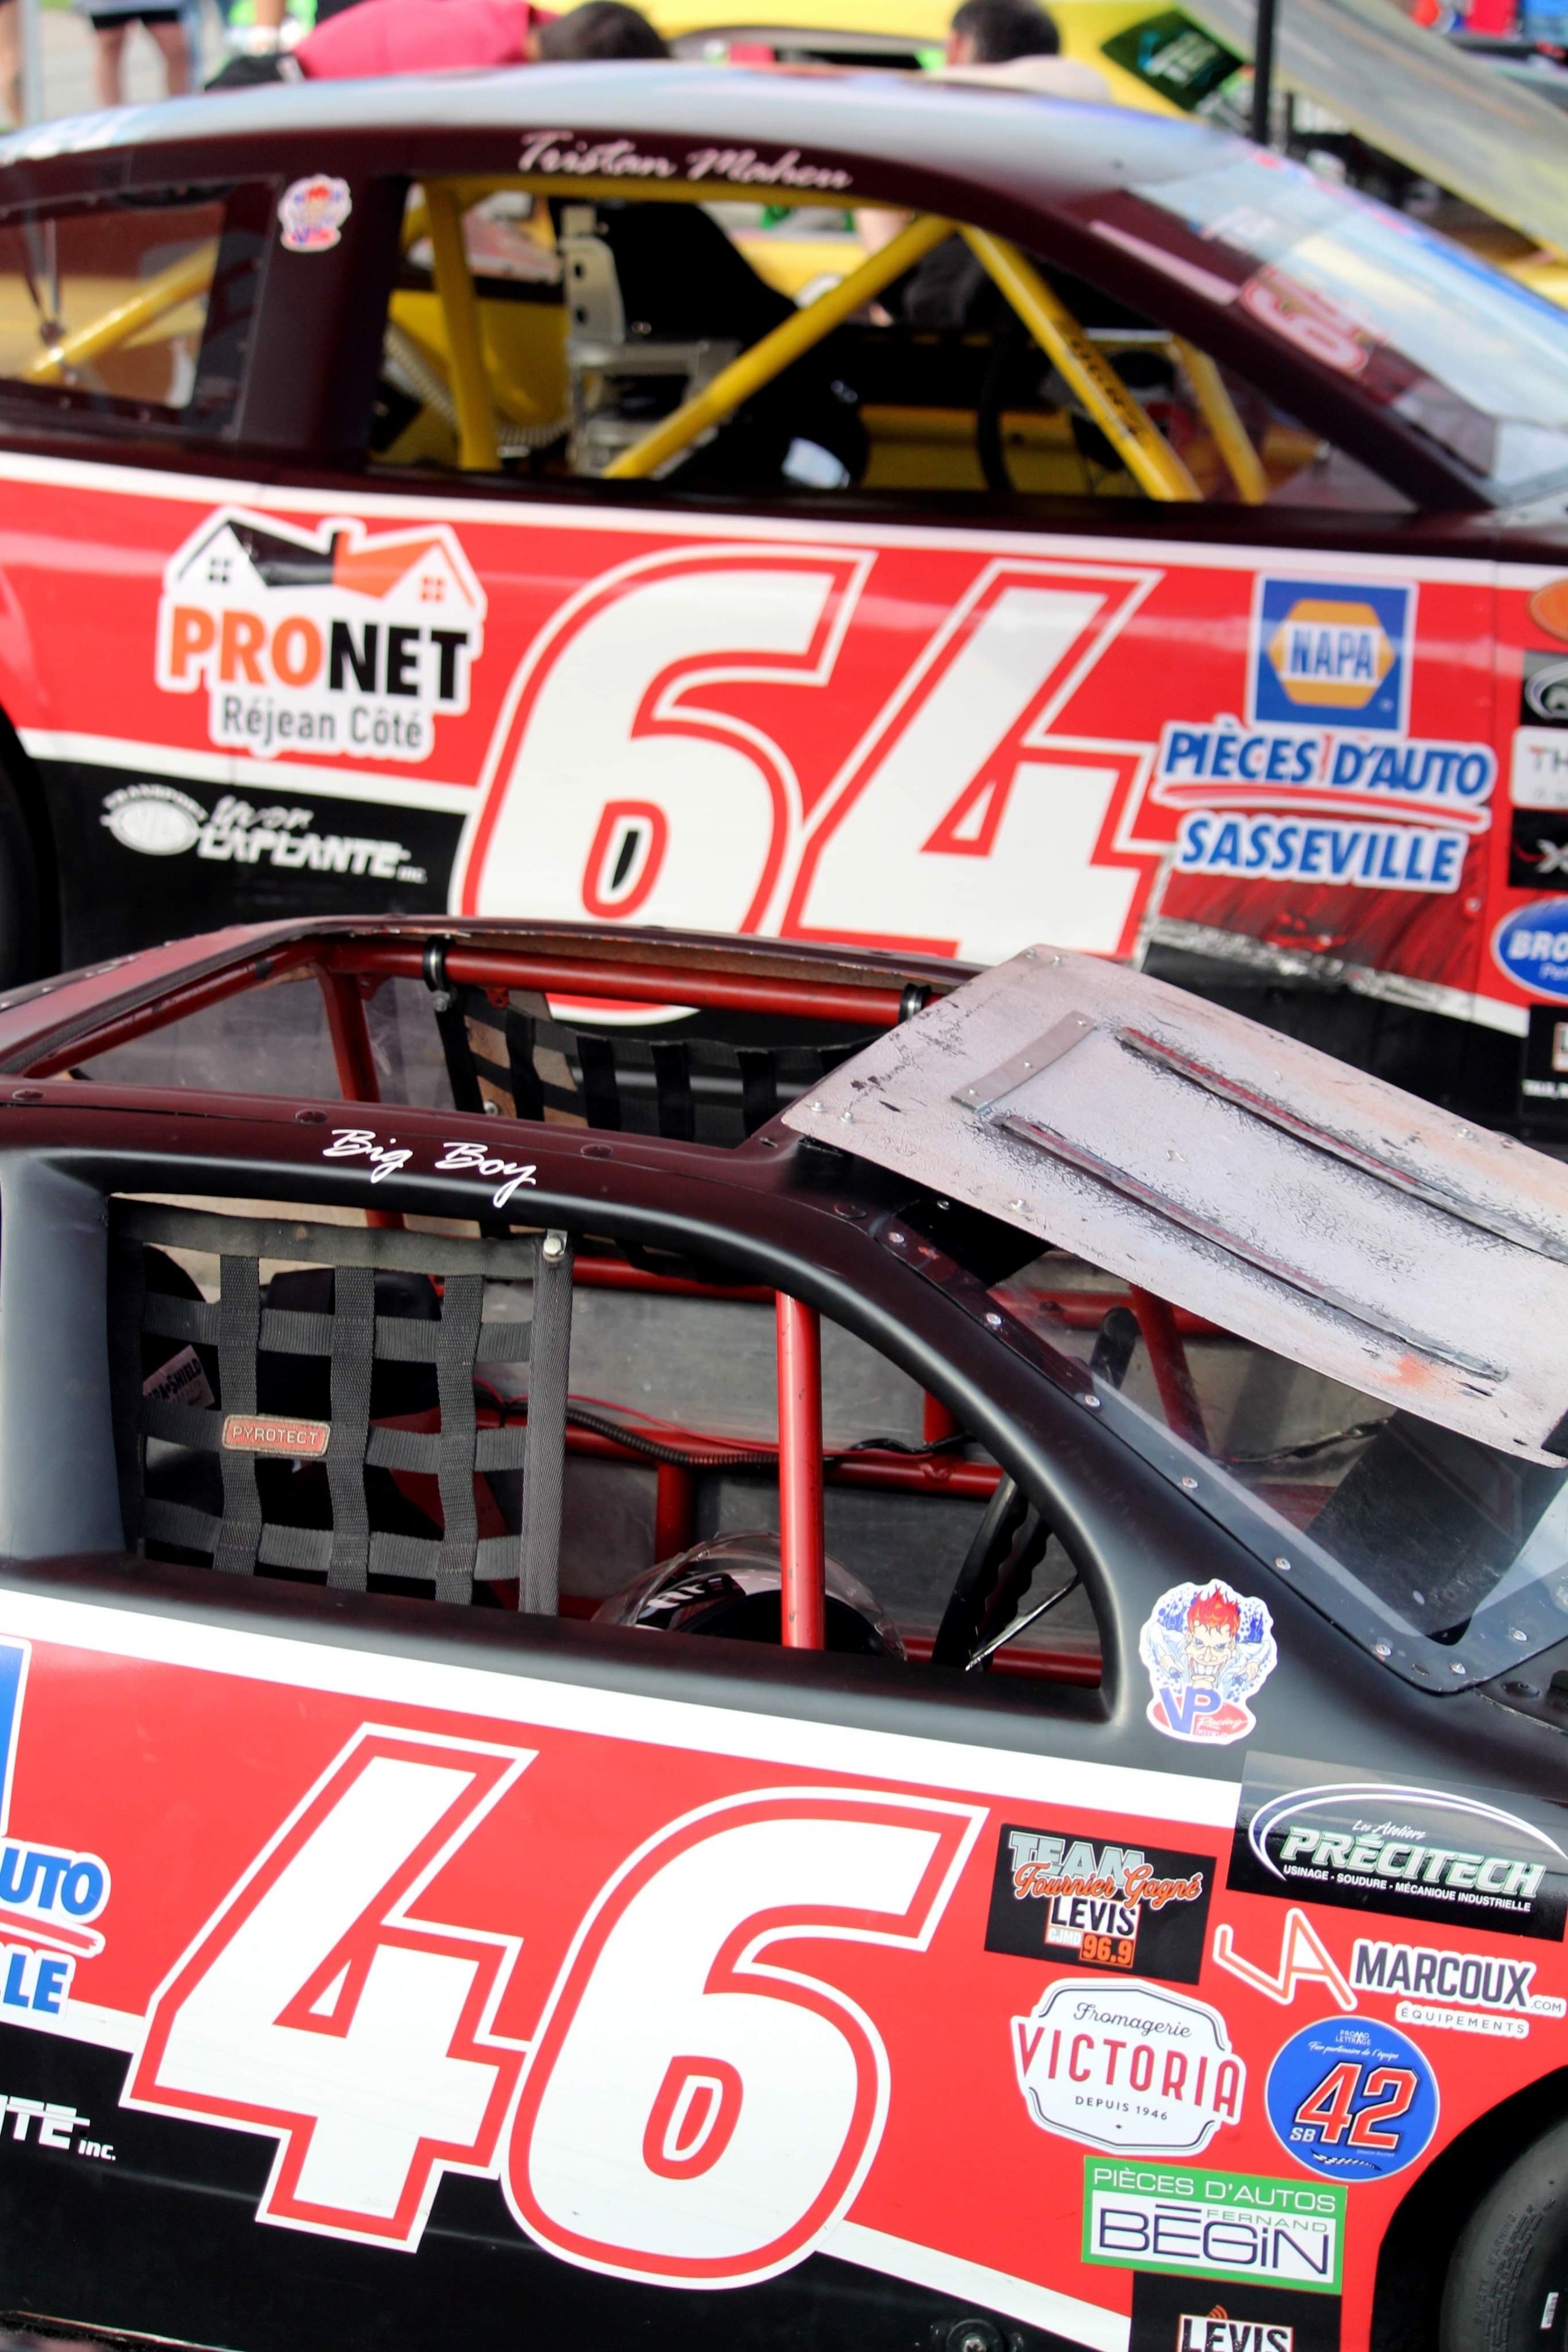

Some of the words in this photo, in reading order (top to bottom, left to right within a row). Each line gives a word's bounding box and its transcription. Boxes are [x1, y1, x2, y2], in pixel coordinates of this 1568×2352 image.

[518, 130, 677, 178] Tristan
[169, 605, 469, 701] PRONET
[1291, 628, 1374, 680] NAPA
[223, 695, 335, 746] Réjean
[350, 705, 422, 748] Côté
[1164, 722, 1317, 783] PIÈCES
[1331, 742, 1488, 796] D'AUTO
[448, 544, 1176, 1024] 64
[197, 824, 412, 878] LAPLANTE
[1182, 818, 1460, 884] SASSEVILLE
[322, 1129, 413, 1184] Big
[434, 1142, 537, 1208] Boy
[232, 1425, 319, 1446] PYROTECT
[1159, 1686, 1222, 1735] VP
[1352, 1819, 1371, 1832] Les
[1373, 1820, 1427, 1840] Ateliers
[1009, 1831, 1145, 1889] TEAM
[1280, 1825, 1547, 1898] PRÉCITECH
[1014, 1862, 1117, 1899] Fournier
[1123, 1864, 1204, 1910] Gagné
[1283, 1864, 1329, 1881] USINAGE
[1336, 1872, 1387, 1890] SOUDURE
[1395, 1880, 1456, 1901] MÉCANIQUE
[1457, 1892, 1532, 1912] INDUSTRIELLE
[1047, 1927, 1082, 1947] CJMD
[1050, 1898, 1137, 1937] LEVIS
[1082, 1934, 1133, 1966] 96.9
[119, 1722, 990, 2290] 46
[1073, 2002, 1193, 2038] Fromagerie
[1400, 2005, 1526, 2035] ÉQUIPEMENTS
[1340, 2029, 1370, 2040] PROMO
[1017, 2022, 1241, 2119] VICTORIA
[1075, 2095, 1130, 2113] DEPUIS
[1135, 2105, 1168, 2121] 1946
[1293, 2060, 1419, 2150] 42
[78, 2139, 117, 2162] inc.
[1289, 2126, 1317, 2143] SB
[1093, 2166, 1195, 2196] PIÈCES
[1205, 2179, 1336, 2213] D'AUTOS
[1206, 2208, 1329, 2233] FERNAND
[1180, 2317, 1290, 2352] LEVIS
